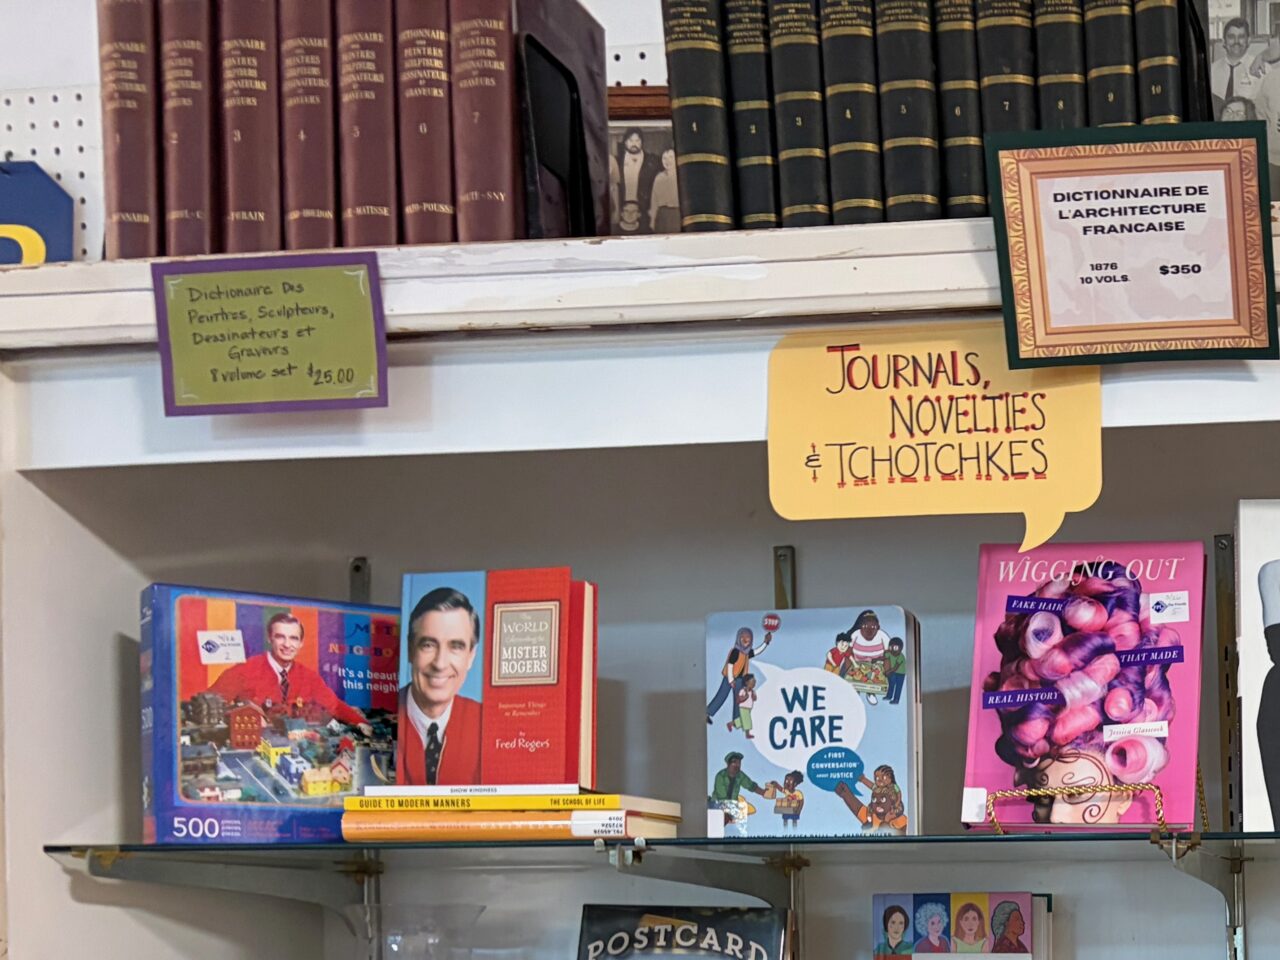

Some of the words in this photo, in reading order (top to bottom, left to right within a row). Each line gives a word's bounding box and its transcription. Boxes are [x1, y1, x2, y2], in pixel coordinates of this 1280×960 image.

[1151, 85, 1162, 95] 10
[1003, 101, 1010, 111] 7
[1057, 100, 1064, 110] 8
[1053, 187, 1182, 203] DICTIONNAIRE
[1185, 186, 1209, 195] DE
[1059, 203, 1207, 219] L'ARCHITECTURE
[1083, 221, 1185, 235] FRANCAISE
[1090, 263, 1118, 271] 1876
[1159, 264, 1201, 275] $350
[188, 285, 273, 302] Dictionaire
[282, 282, 304, 293] Des
[192, 328, 289, 345] Dessinateurs
[297, 325, 316, 337] et
[271, 363, 297, 376] set
[308, 363, 354, 386] $25.00
[826, 344, 991, 394] JOURNALS,
[889, 392, 1046, 438] NOVELTIES
[825, 439, 1048, 488] TCHOTCHKES
[999, 554, 1116, 586] WIGGING
[1125, 557, 1185, 580] OUT
[1012, 600, 1036, 610] FAKE
[1039, 602, 1064, 612] HAIR
[502, 622, 549, 634] WORLD
[502, 646, 547, 660] MISTER
[1120, 652, 1148, 663] THAT
[1150, 650, 1178, 660] MADE
[502, 660, 547, 674] ROGERS
[781, 685, 826, 713] WE
[988, 694, 1014, 704] REAL
[1017, 692, 1060, 702] HISTORY
[769, 715, 844, 750] CARE
[496, 739, 516, 749] Fred
[518, 738, 549, 752] Rogers
[359, 800, 383, 808] GUIDE
[386, 800, 395, 808] TO
[398, 799, 430, 808] MODERN
[433, 798, 471, 808] MANNERS
[172, 817, 220, 839] 500
